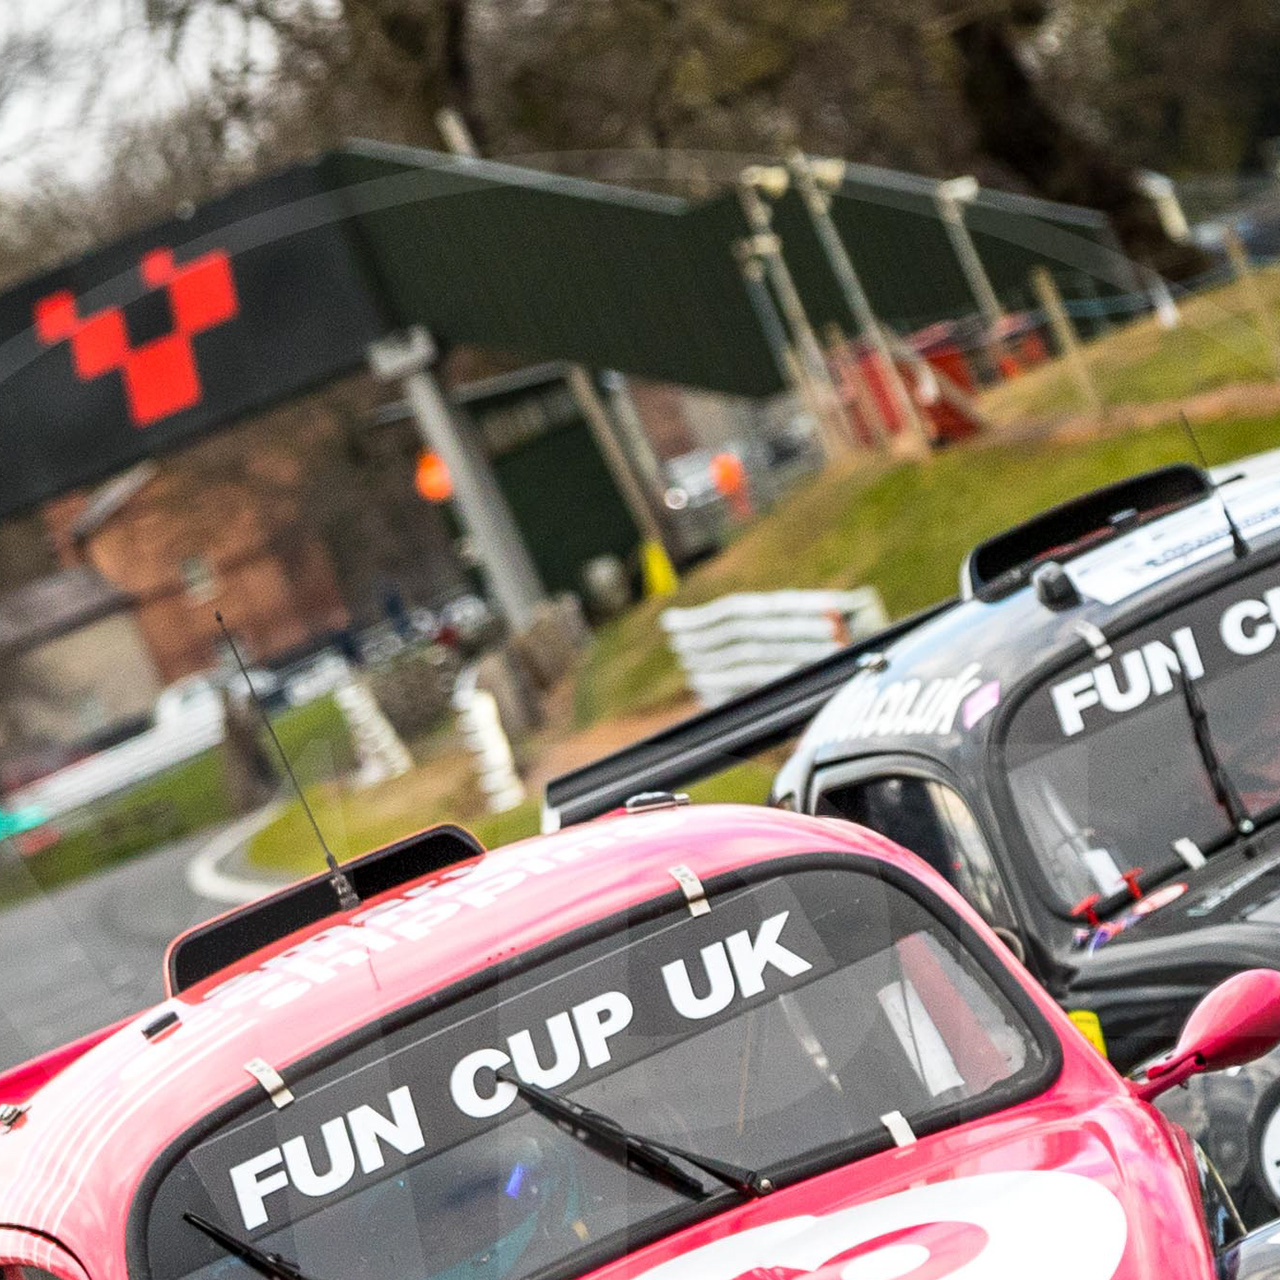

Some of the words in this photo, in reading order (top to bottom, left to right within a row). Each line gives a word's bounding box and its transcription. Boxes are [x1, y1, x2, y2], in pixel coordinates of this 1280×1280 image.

[1051, 627, 1204, 737] FUN
[230, 1085, 424, 1230] FUN
[449, 990, 634, 1118] CUP
[661, 910, 813, 1020] UK
